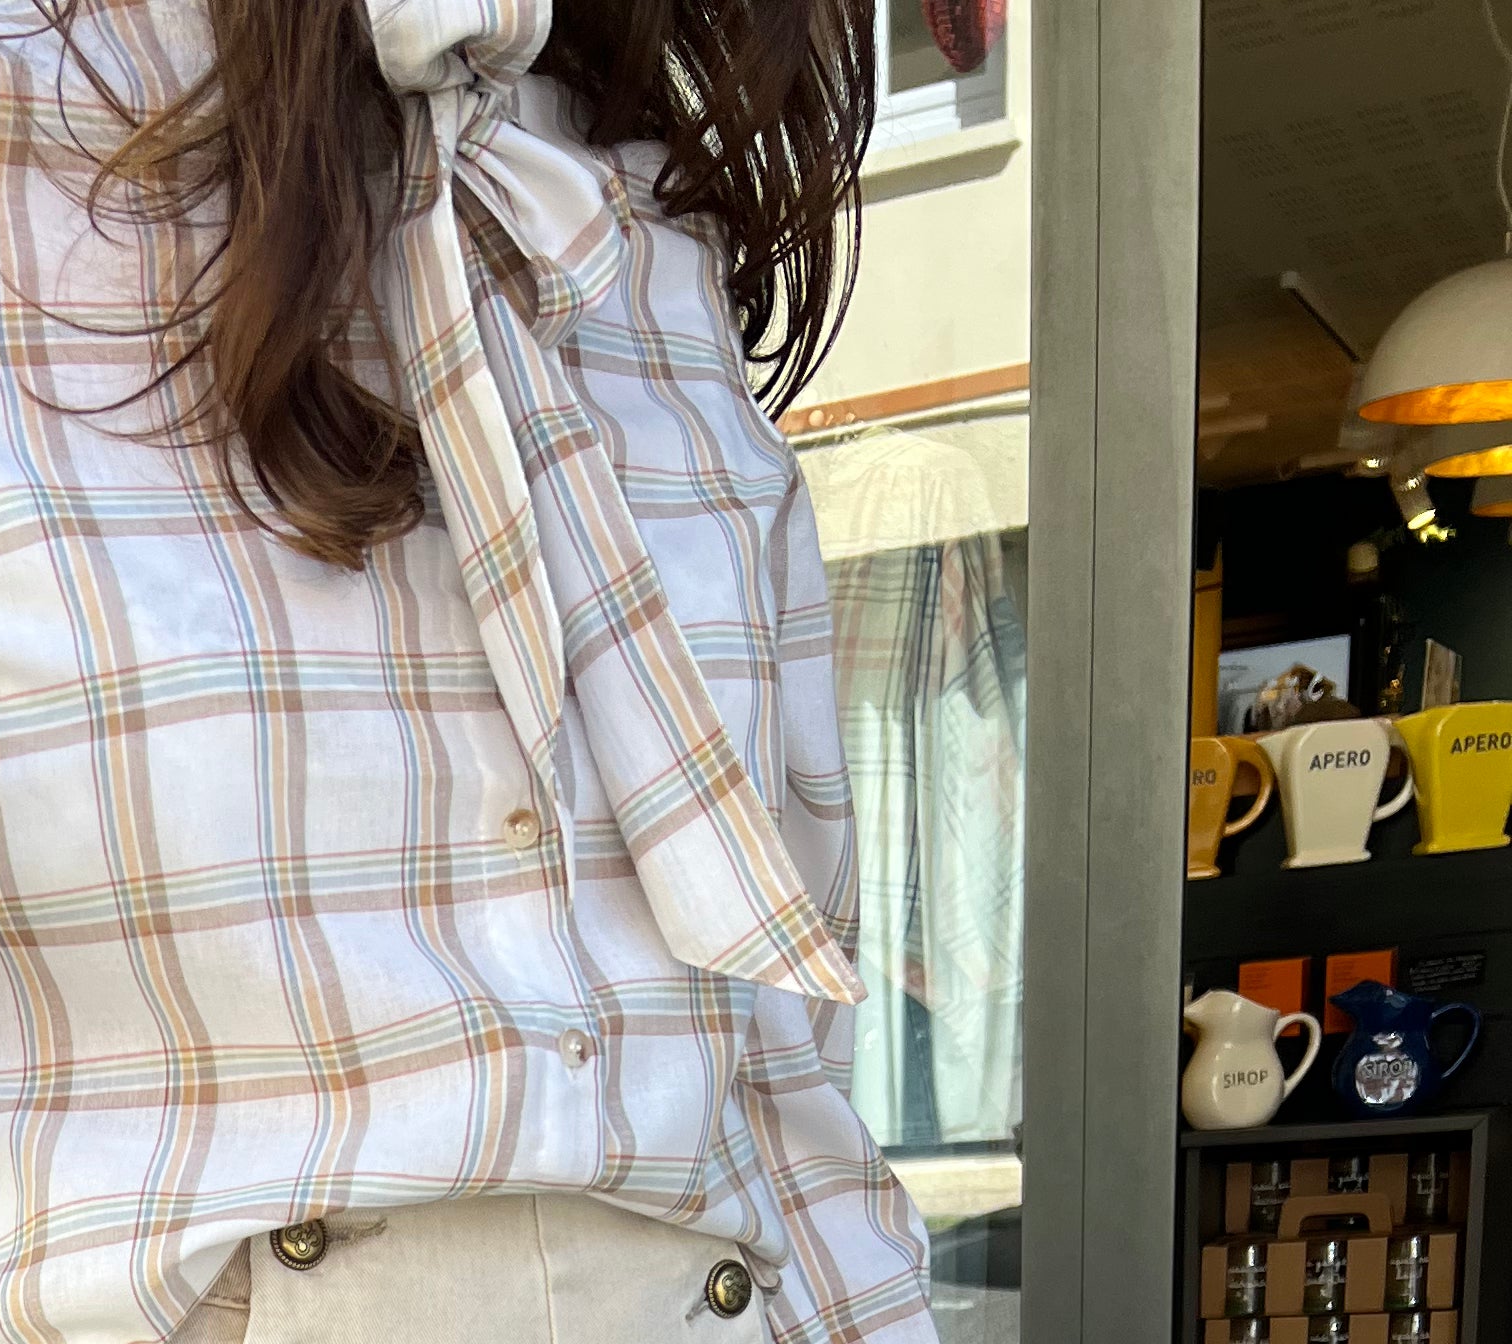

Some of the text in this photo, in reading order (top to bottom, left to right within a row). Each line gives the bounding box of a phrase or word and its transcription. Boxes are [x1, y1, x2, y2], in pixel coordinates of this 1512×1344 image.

[1450, 732, 1512, 755] APERO
[1309, 750, 1371, 771] APERO
[1223, 1070, 1268, 1088] SIROP
